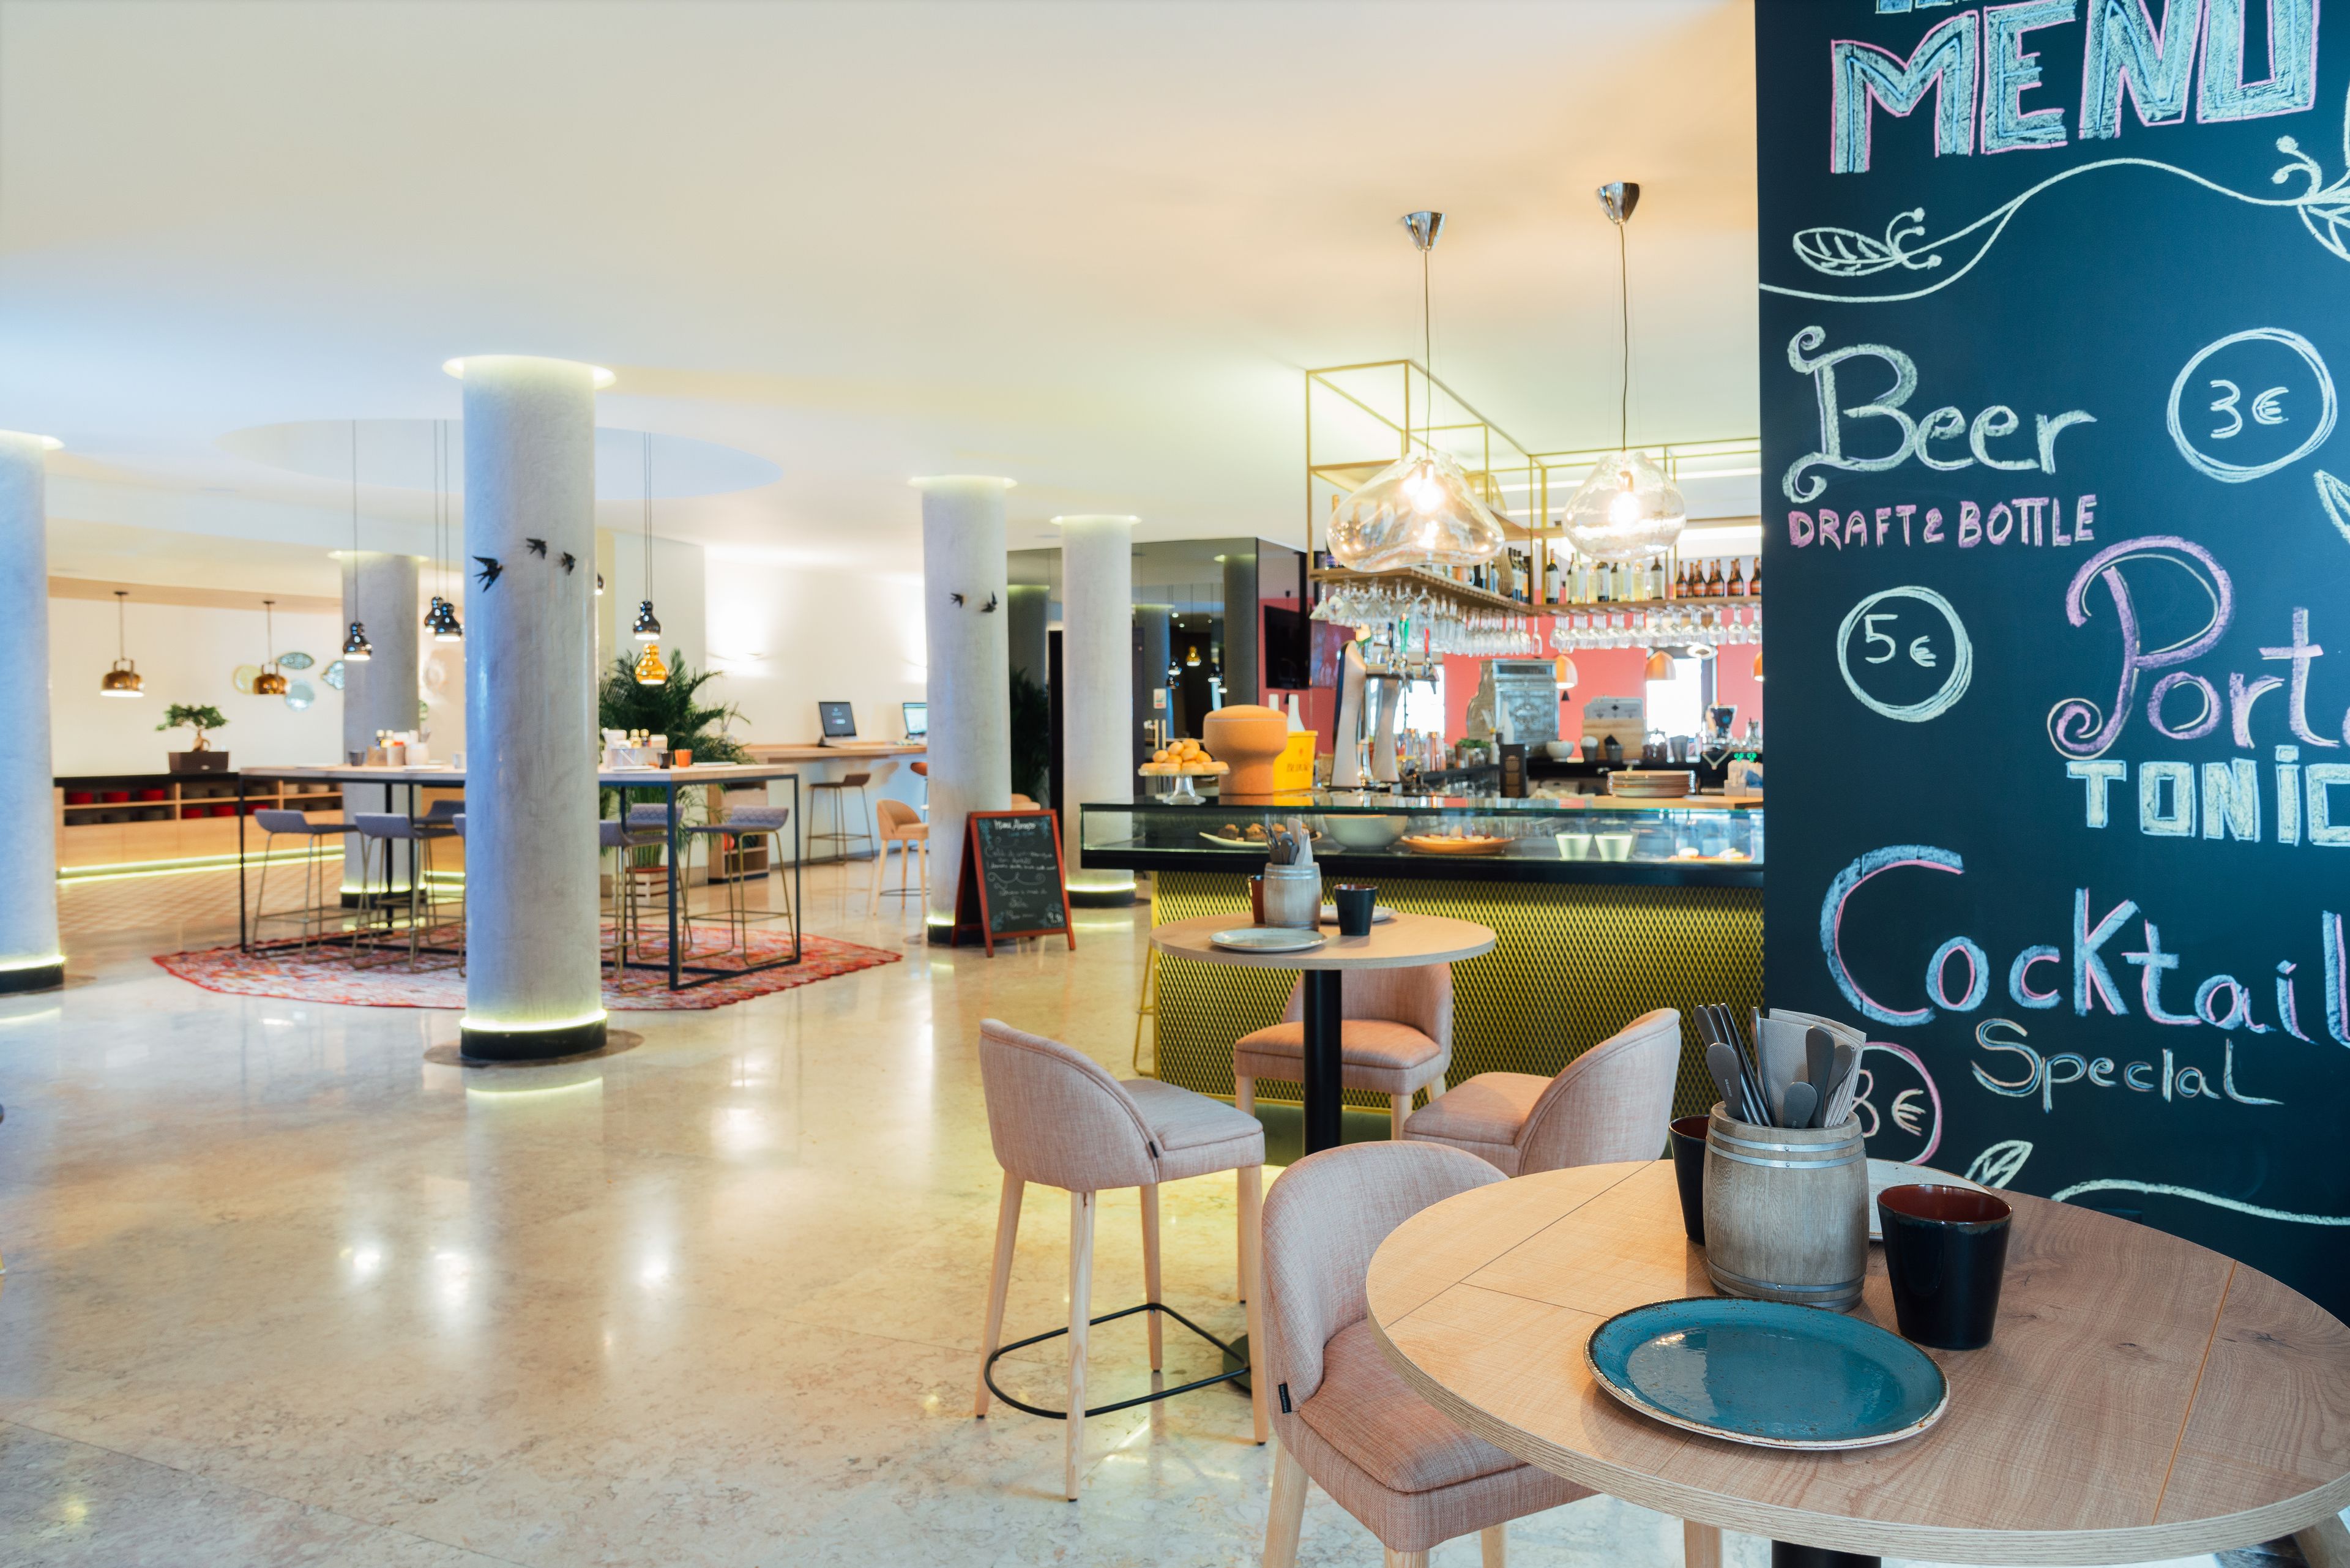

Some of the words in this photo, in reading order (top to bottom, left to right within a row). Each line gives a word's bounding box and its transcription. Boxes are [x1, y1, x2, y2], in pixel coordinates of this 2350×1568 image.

[1830, 0, 2322, 174] MENU
[1782, 325, 2098, 504] Beer
[1788, 504, 1917, 550] DRAFT
[1958, 494, 2098, 548] BOTTLE
[2047, 534, 2350, 761] Port
